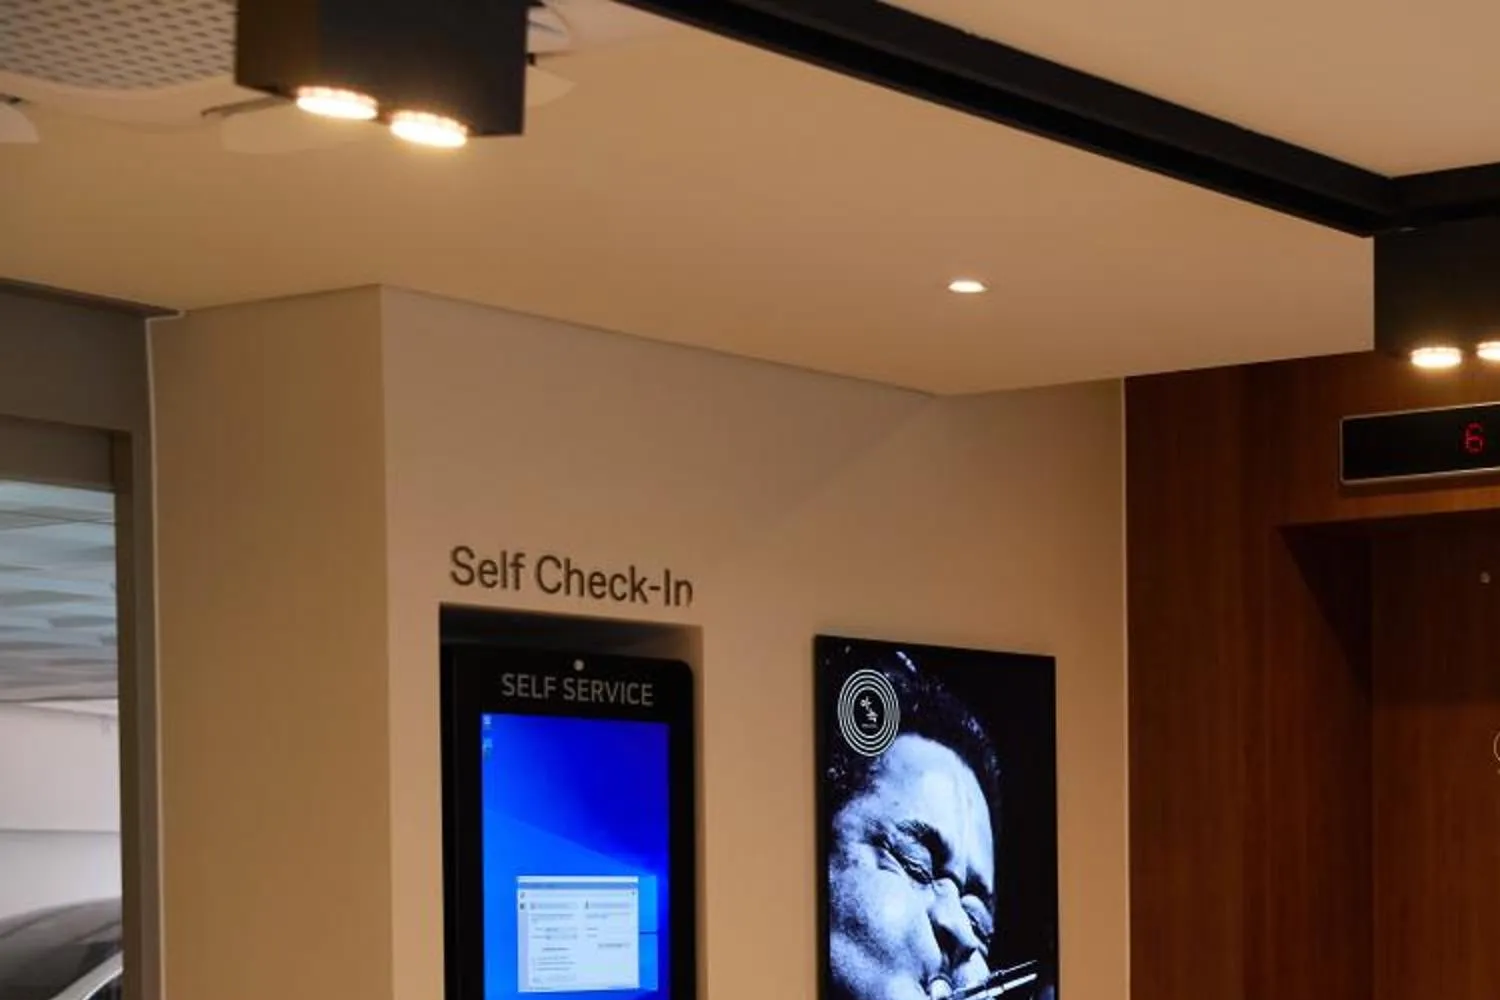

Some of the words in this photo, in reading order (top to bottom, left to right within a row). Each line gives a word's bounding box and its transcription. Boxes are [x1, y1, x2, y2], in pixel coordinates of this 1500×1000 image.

[1464, 422, 1486, 454] 6
[450, 546, 526, 590] Self
[534, 554, 694, 607] Check-In
[501, 672, 557, 699] SELF
[563, 677, 654, 707] SERVICE
